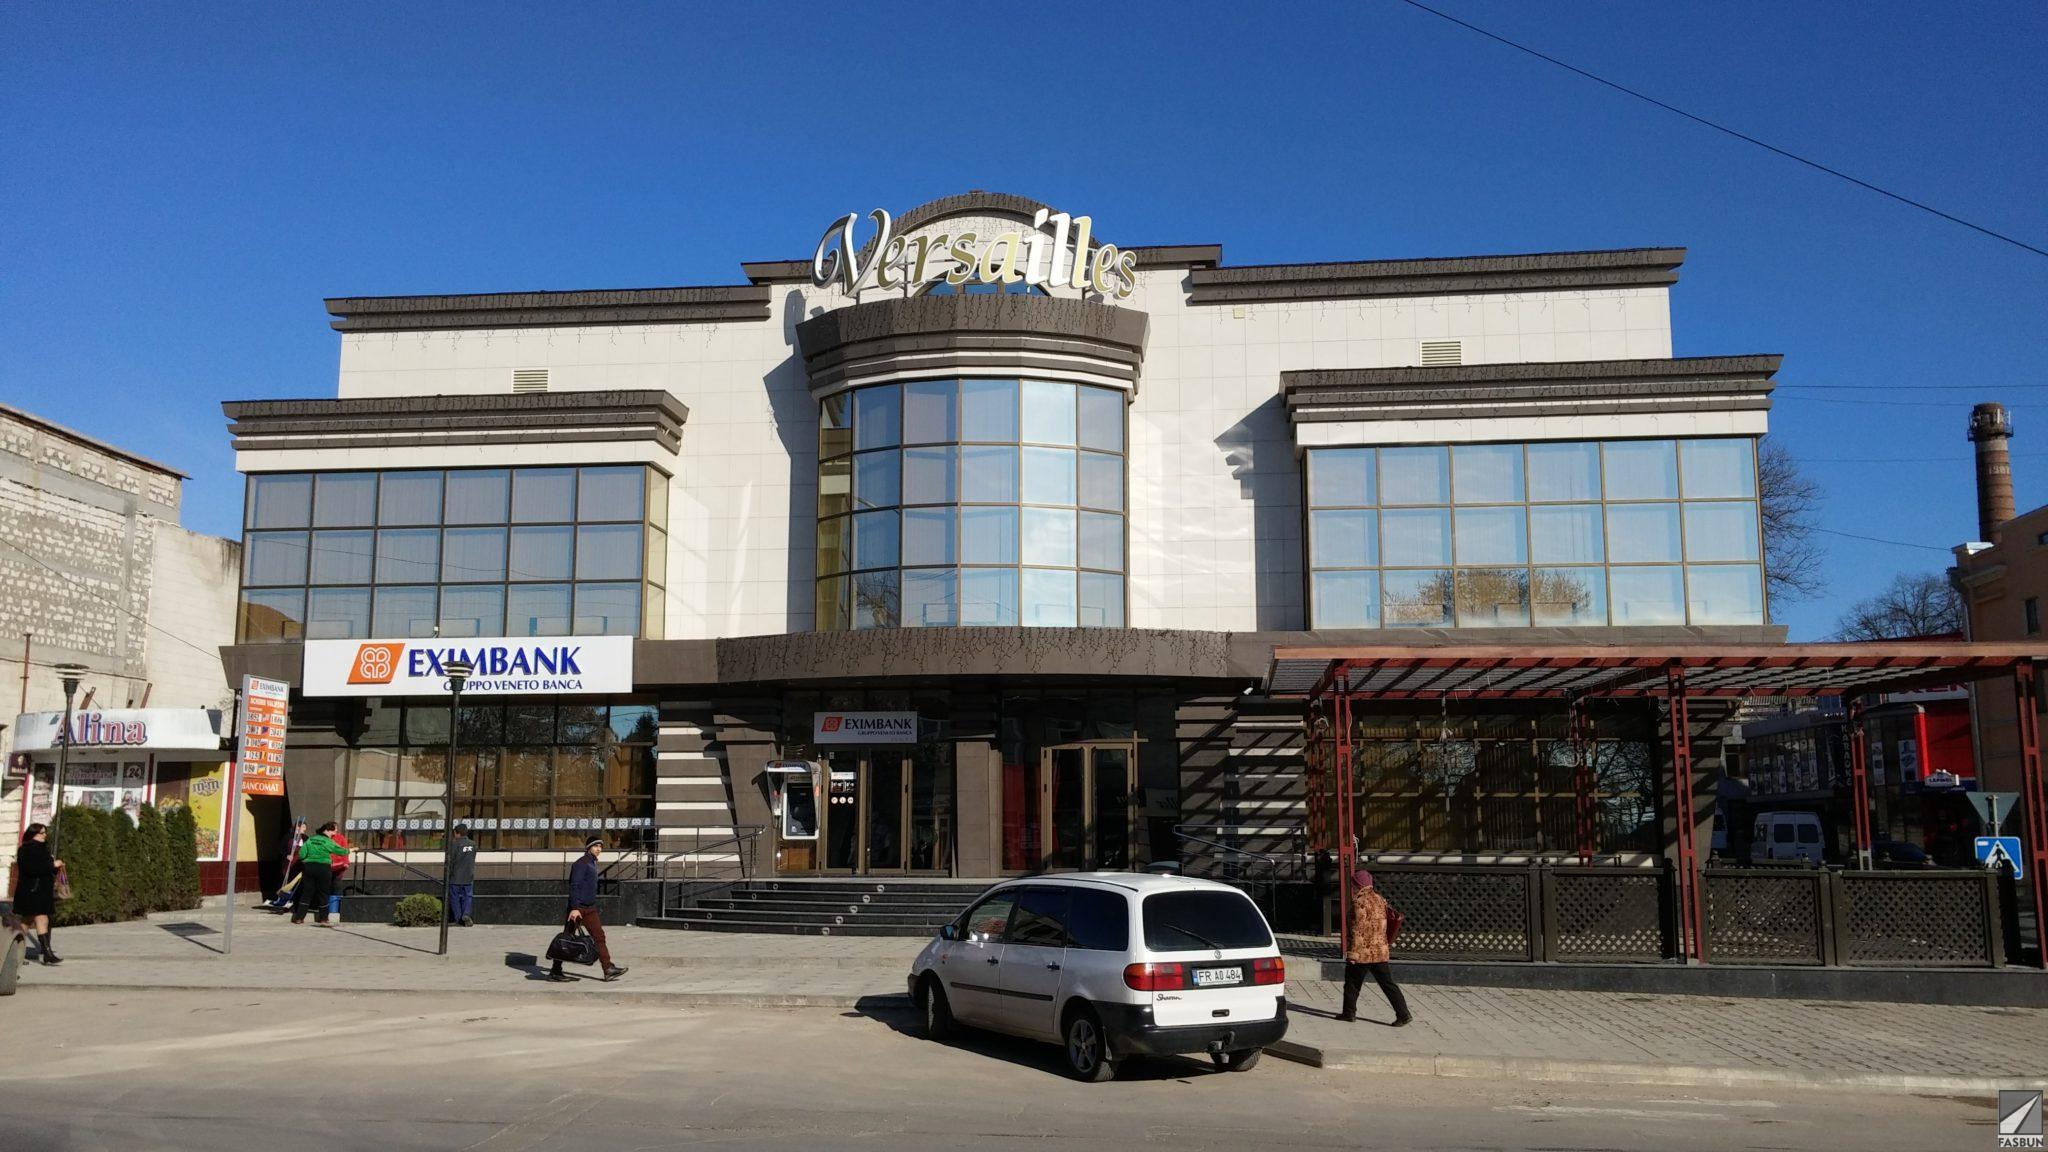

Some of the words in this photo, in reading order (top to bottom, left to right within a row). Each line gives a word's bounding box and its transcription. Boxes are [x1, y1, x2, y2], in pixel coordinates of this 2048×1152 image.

[811, 208, 1138, 300] Versailles
[408, 646, 583, 678] EXIMBANK
[442, 680, 493, 692] GUPPO
[494, 680, 540, 691] VENETO
[542, 679, 583, 691] BANCA
[51, 713, 148, 747] Alina
[845, 718, 913, 730] EXIMBANK
[242, 781, 280, 793] BANCOMAT
[1198, 971, 1212, 982] FR
[1225, 969, 1242, 980] 484
